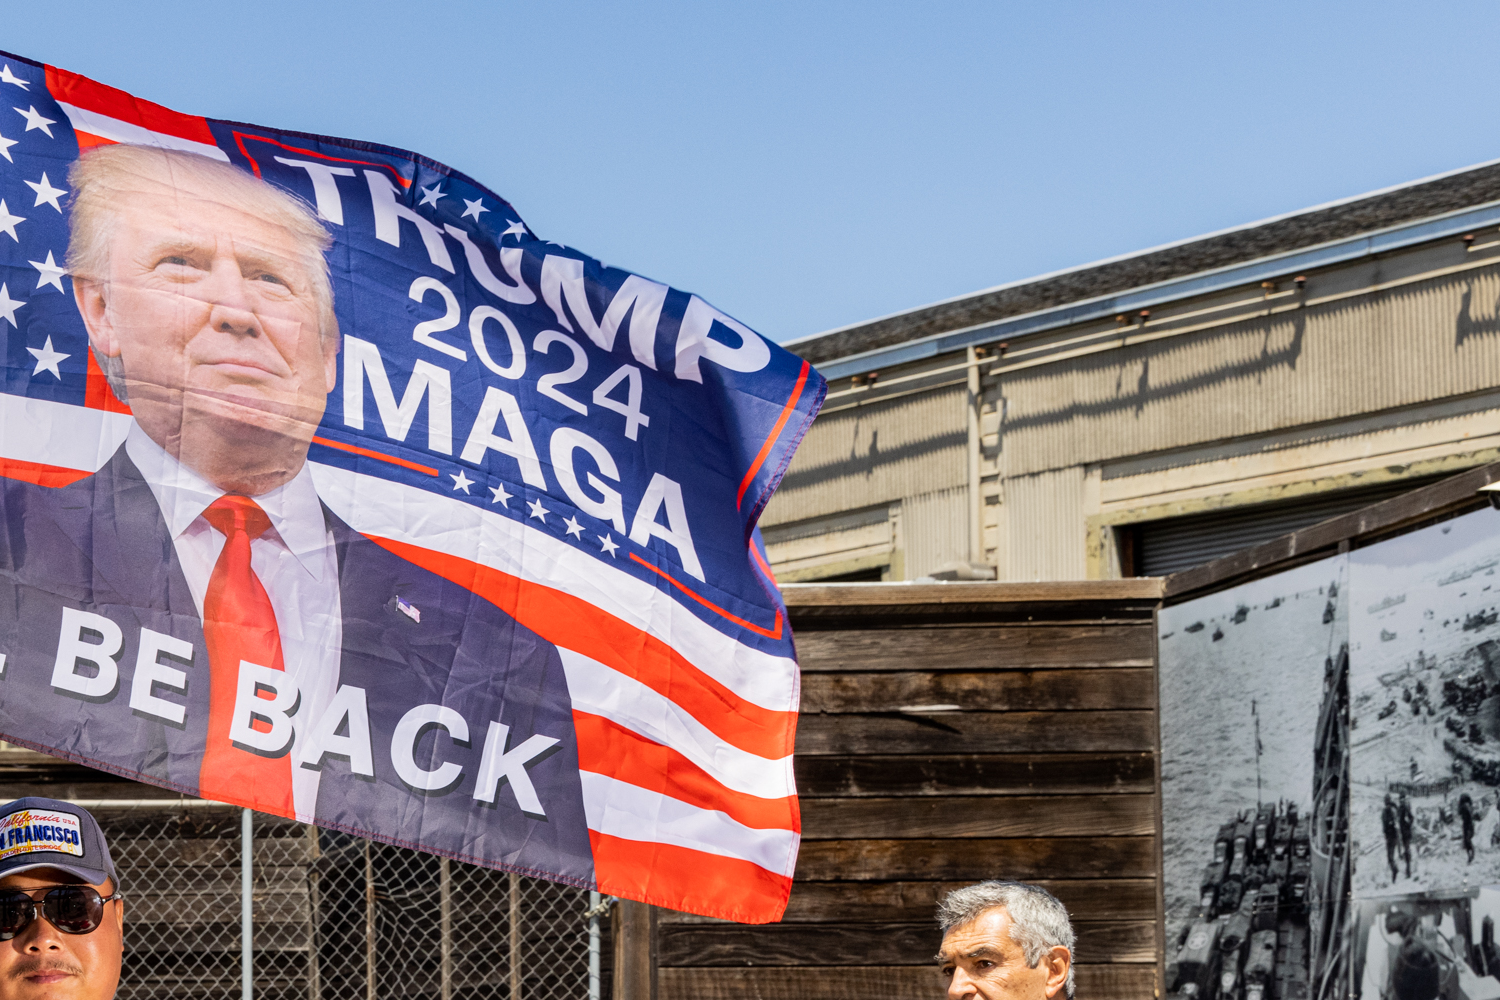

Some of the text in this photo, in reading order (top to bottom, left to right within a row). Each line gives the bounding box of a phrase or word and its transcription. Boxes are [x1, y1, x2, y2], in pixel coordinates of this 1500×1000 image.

[273, 155, 772, 385] TRUMP
[408, 275, 650, 441] 2024
[343, 333, 706, 583] MAGA
[50, 606, 195, 726] BE
[228, 659, 562, 818] BACK
[8, 824, 80, 847] FRANCISCO
[62, 818, 76, 826] USA
